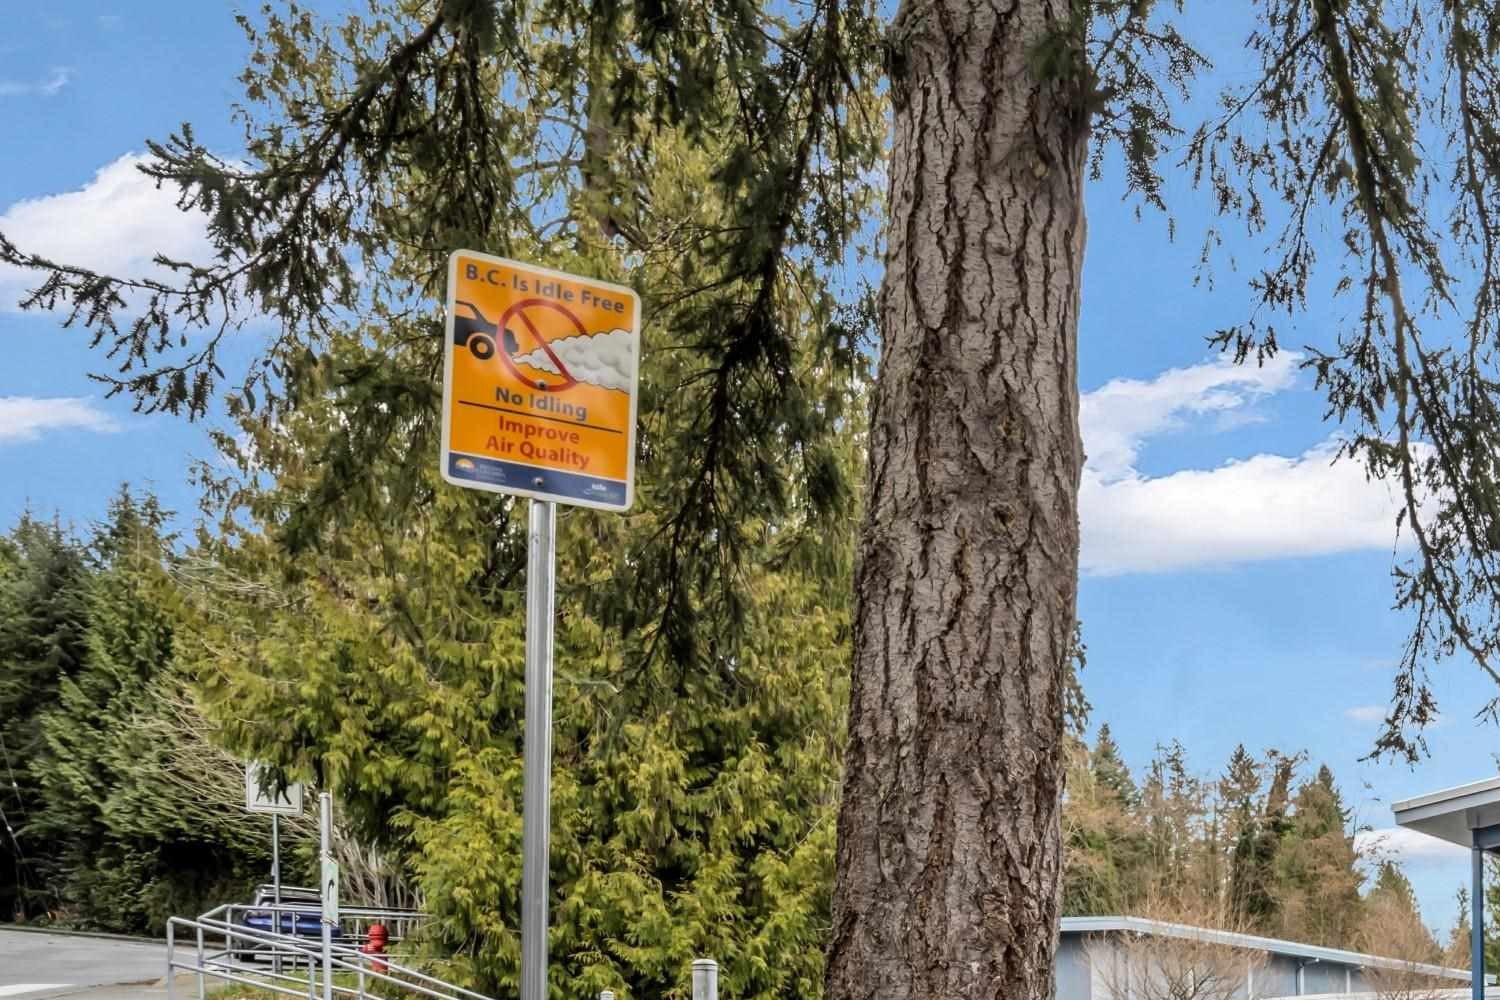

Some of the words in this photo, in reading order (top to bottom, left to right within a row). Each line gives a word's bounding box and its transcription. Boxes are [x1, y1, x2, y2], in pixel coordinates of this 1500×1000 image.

[465, 263, 507, 287] B.C.
[512, 275, 529, 293] Is
[535, 279, 574, 302] Idle
[581, 290, 625, 314] Free
[495, 386, 523, 406] No
[529, 393, 587, 421] Idling
[499, 416, 580, 444] Improve
[486, 435, 515, 453] Air
[520, 441, 590, 468] Quality
